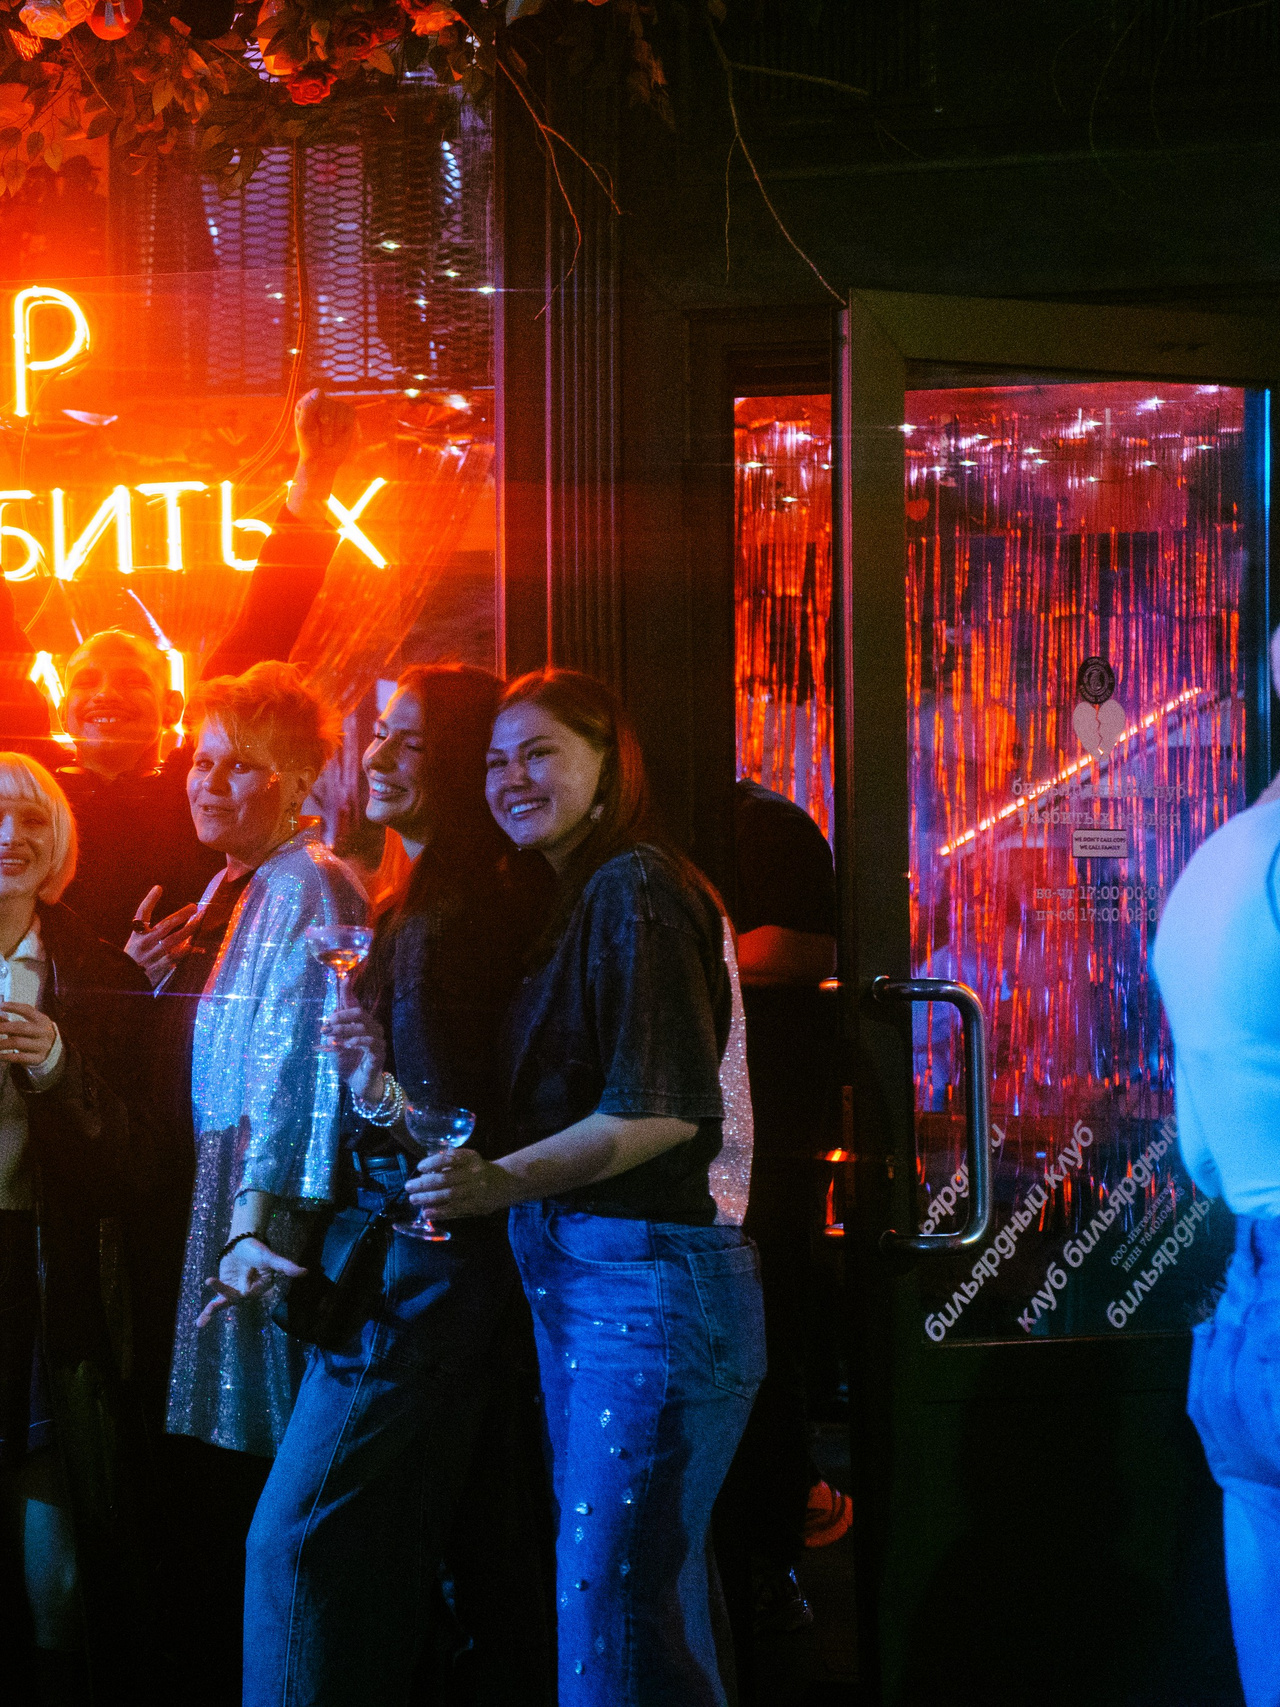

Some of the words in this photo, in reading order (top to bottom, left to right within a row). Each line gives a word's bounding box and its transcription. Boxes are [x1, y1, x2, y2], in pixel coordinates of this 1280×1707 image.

[924, 1182, 1048, 1343] бильярдный
[1045, 1119, 1094, 1191] клуб
[1016, 1261, 1068, 1334] клуб
